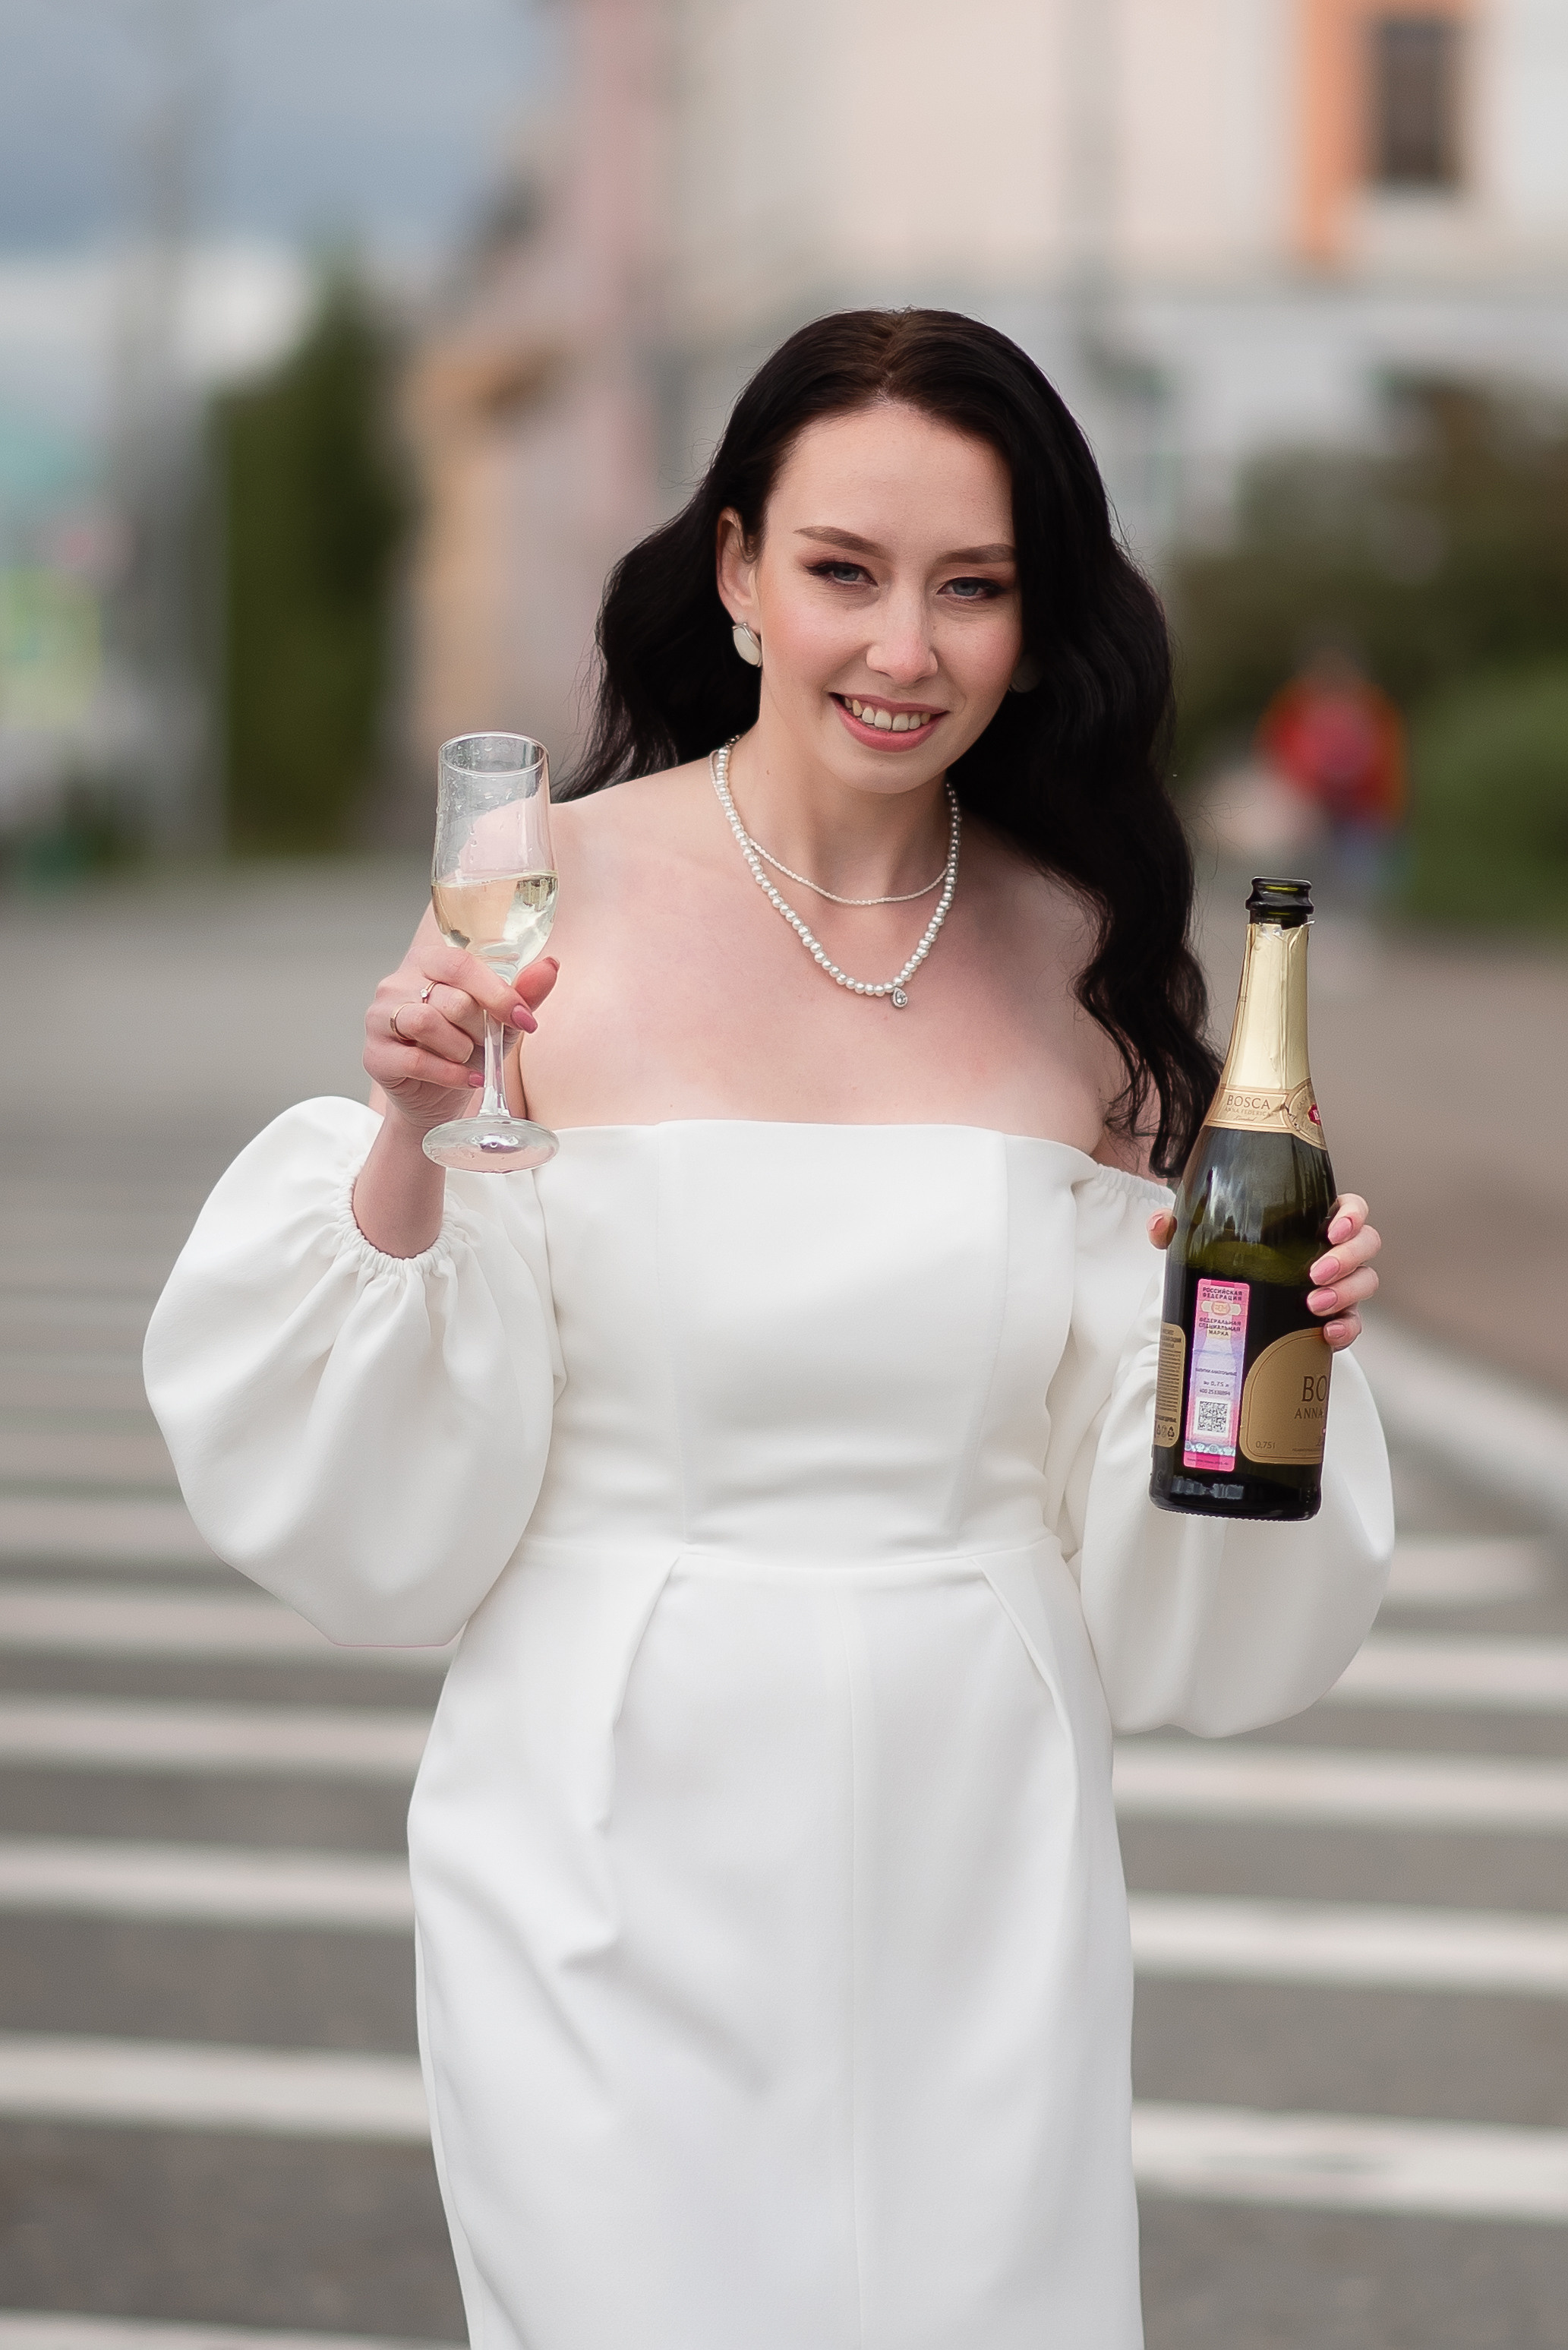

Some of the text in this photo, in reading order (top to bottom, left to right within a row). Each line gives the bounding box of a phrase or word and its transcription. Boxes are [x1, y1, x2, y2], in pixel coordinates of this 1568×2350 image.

[1226, 1094, 1270, 1110] BOSCA
[1202, 1287, 1243, 1296] РОССИЙСКАЯ
[1202, 1293, 1242, 1301] ФЕДЕРАЦИЯ
